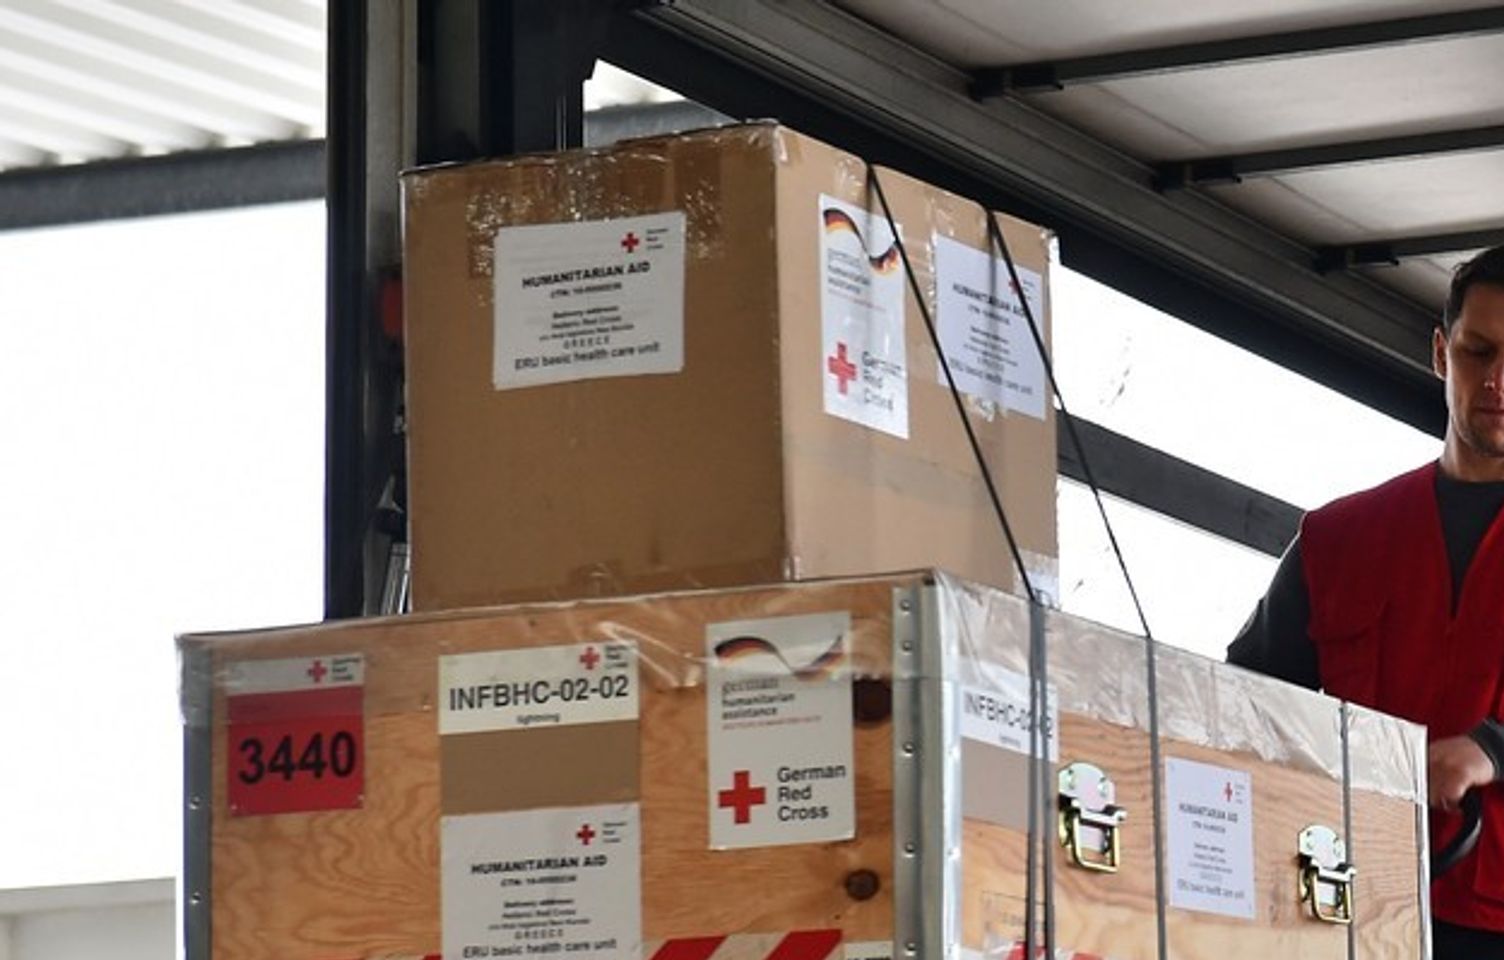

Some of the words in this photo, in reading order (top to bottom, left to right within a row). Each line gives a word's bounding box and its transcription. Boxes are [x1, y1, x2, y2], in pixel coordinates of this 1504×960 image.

[522, 264, 624, 289] HUMANITARIAN
[627, 261, 651, 274] AID
[541, 353, 571, 367] basic
[574, 348, 608, 363] health
[611, 347, 635, 358] care
[449, 674, 629, 711] INFBHC-02-02
[238, 730, 356, 785] 3440
[777, 764, 847, 784] German
[777, 785, 813, 802] Red
[777, 804, 830, 822] Cross
[470, 857, 579, 875] HUMANITARIAN
[582, 854, 608, 867] AID
[491, 942, 524, 957] basic
[526, 941, 562, 955] health
[565, 940, 590, 952] care
[593, 937, 617, 949] unit
